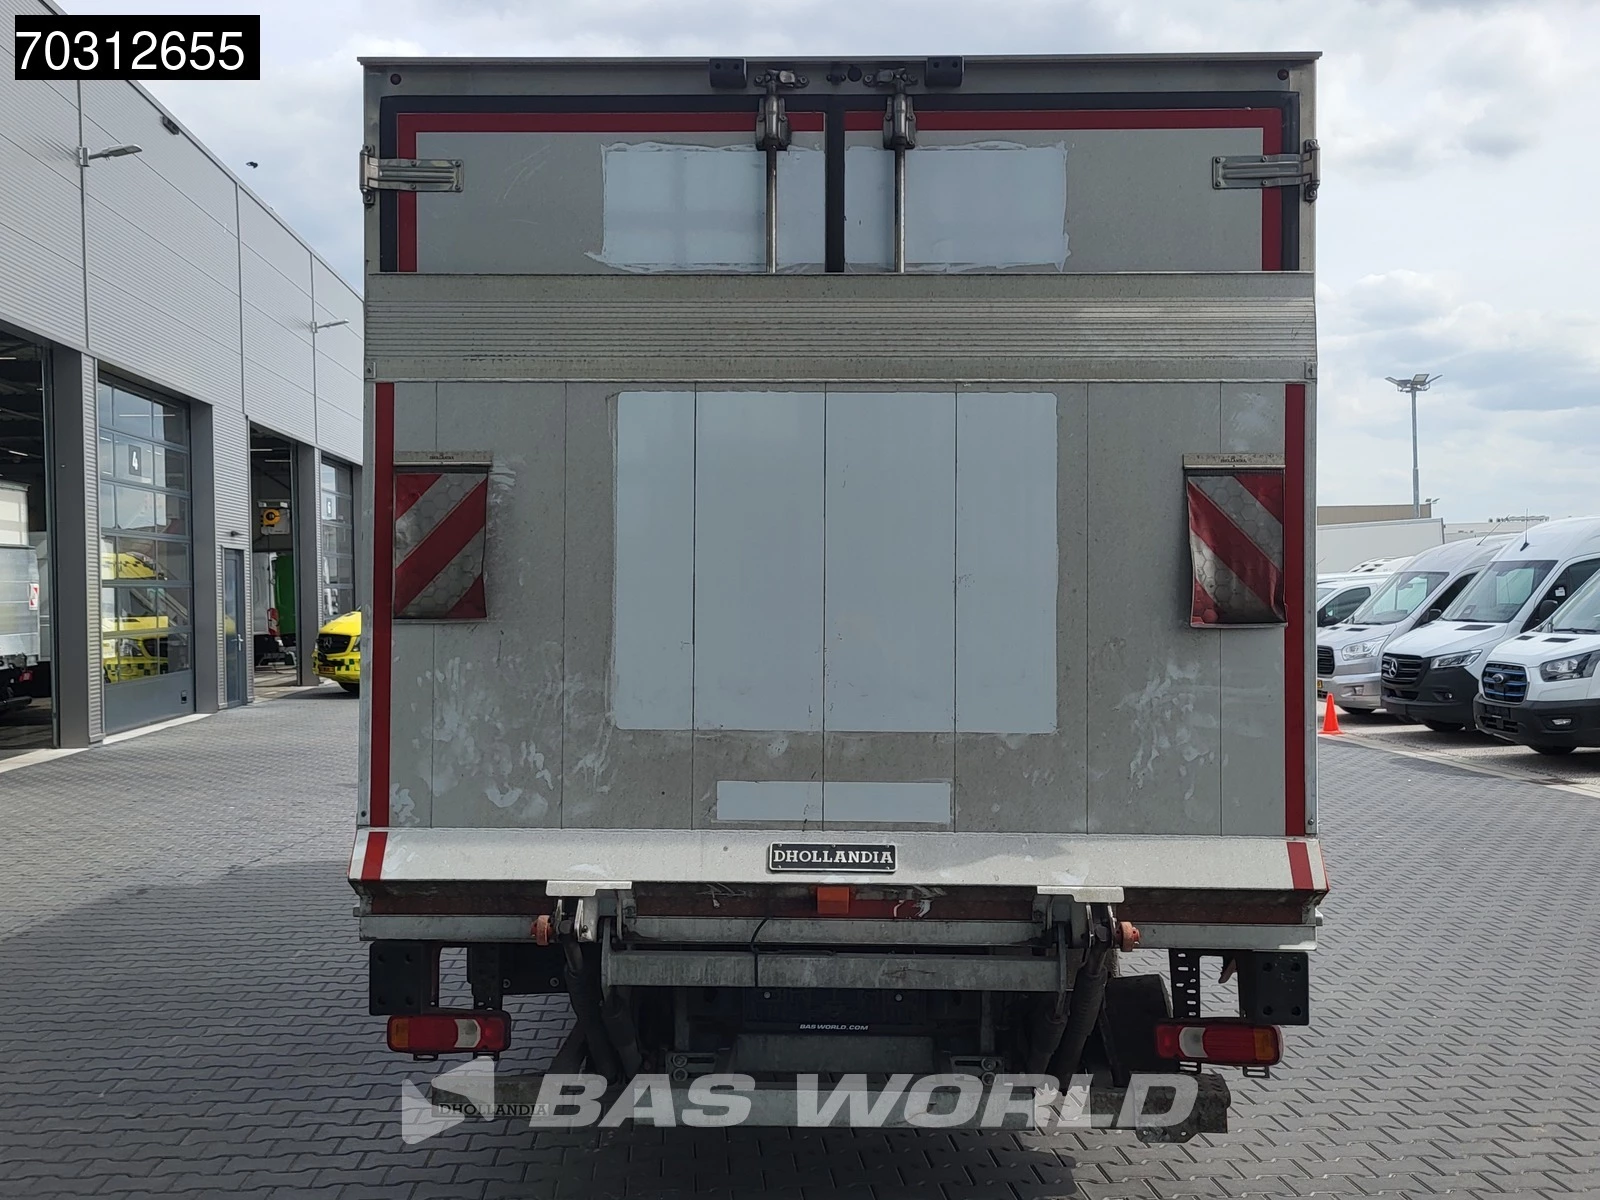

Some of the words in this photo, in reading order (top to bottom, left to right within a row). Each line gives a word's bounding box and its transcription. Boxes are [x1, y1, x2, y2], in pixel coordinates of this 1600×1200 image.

[132, 451, 138, 470] 4
[773, 850, 894, 863] DHOLLANDIA
[817, 1023, 869, 1031] WORLD.COM
[440, 1103, 548, 1116] DHOLLANDIA
